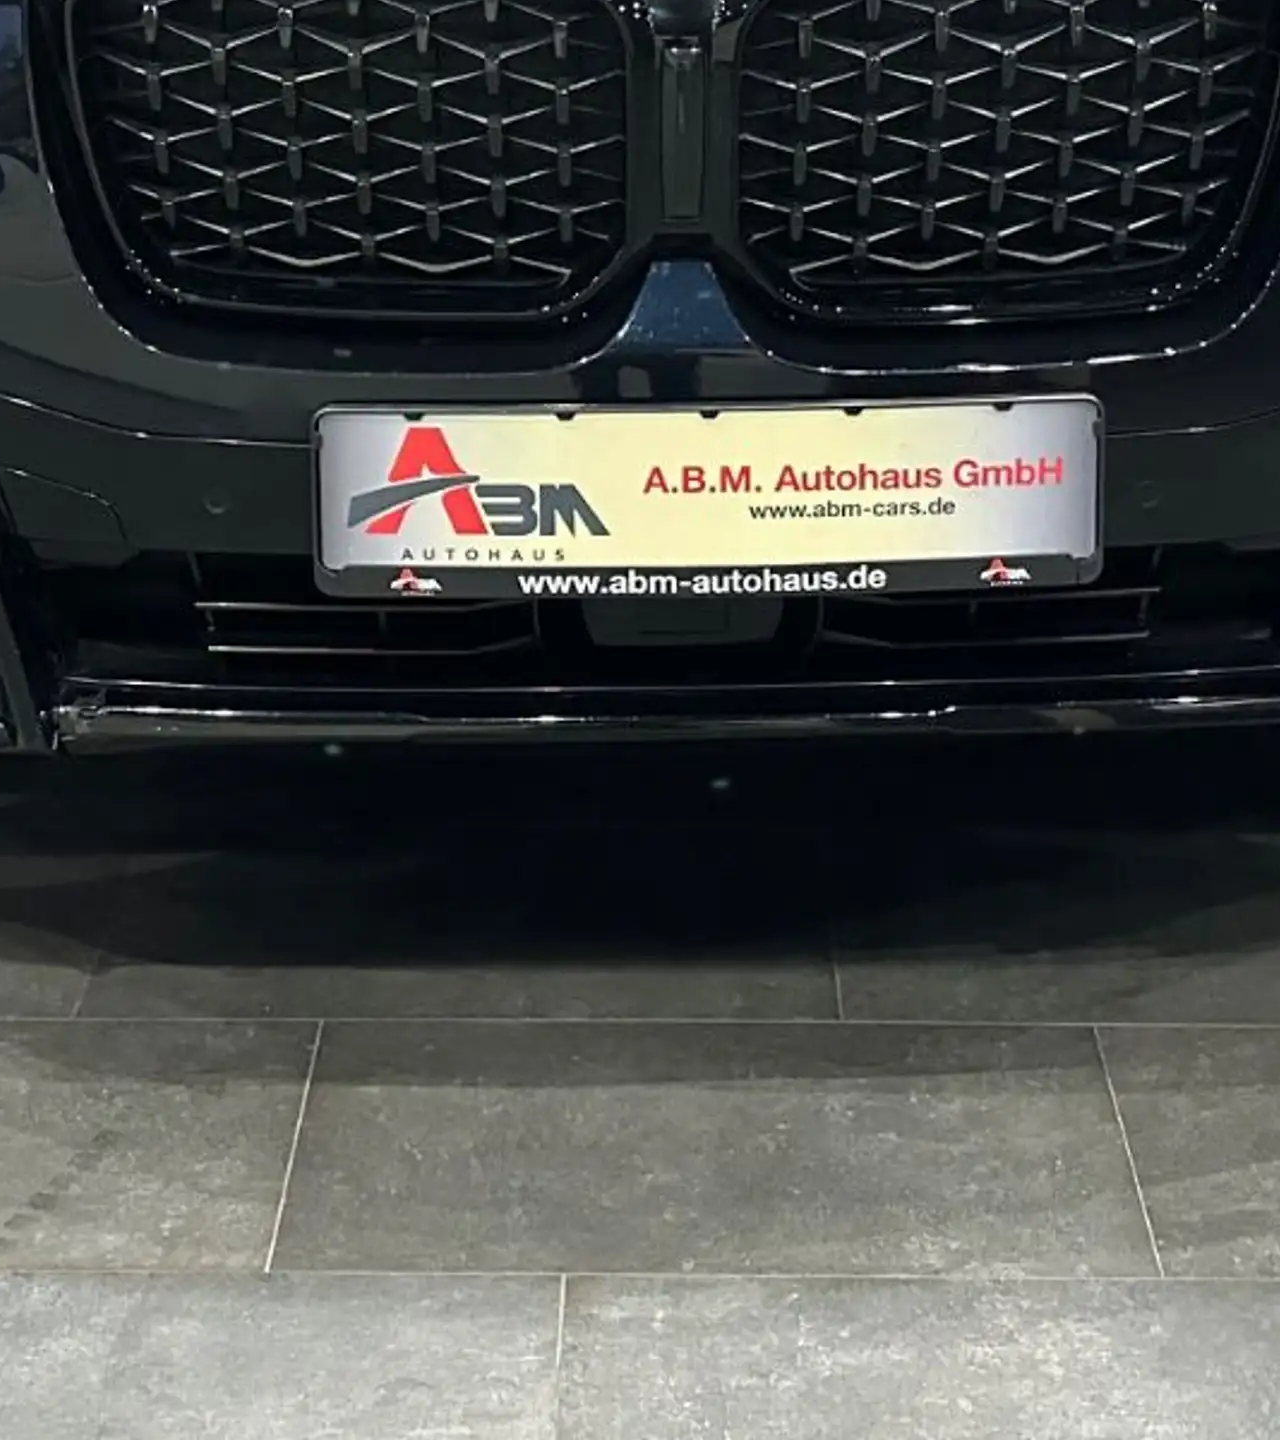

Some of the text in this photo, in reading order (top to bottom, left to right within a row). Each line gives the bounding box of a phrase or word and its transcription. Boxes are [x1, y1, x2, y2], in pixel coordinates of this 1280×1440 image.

[348, 427, 610, 538] ABM
[643, 456, 1064, 494] A.B.M. Autohaus GmbH
[748, 496, 956, 520] www.abm-cars.de
[401, 548, 565, 561] AUTOHAUS
[518, 564, 887, 595] www.abm-autohaus.de
